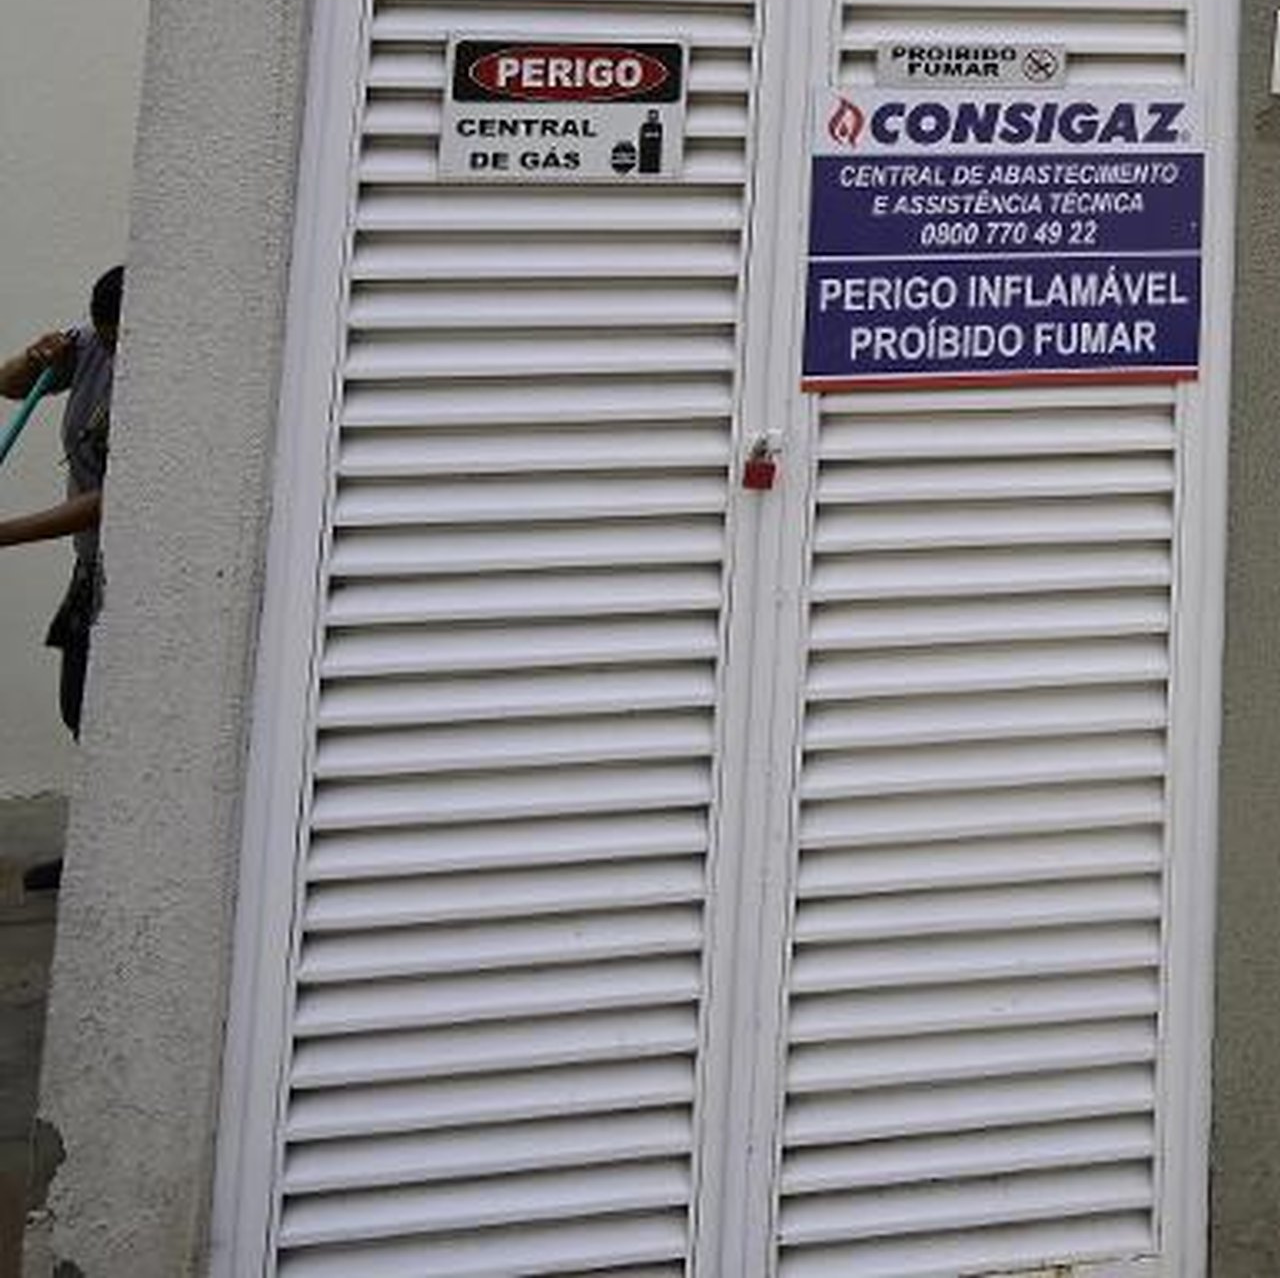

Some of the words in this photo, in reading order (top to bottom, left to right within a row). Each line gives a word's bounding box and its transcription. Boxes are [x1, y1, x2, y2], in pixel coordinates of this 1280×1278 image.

[891, 46, 1017, 61] PROIBIDO
[496, 58, 643, 89] PERIGO
[907, 63, 1000, 78] FUMAR
[456, 118, 597, 138] CENTRAL
[870, 101, 1186, 145] CONSIGAZ
[470, 152, 510, 171] DE
[519, 146, 581, 171] GÁS
[839, 165, 946, 188] CENTRAL
[951, 165, 982, 186] DE
[988, 162, 1179, 185] ABASTECIMENTO
[871, 194, 890, 215] E
[894, 189, 1043, 215] ASSISTÊNCIA
[1050, 187, 1144, 214] TÉCNICA
[920, 223, 979, 246] 0800
[986, 223, 1027, 245] 770
[1034, 221, 1064, 245] 49
[1069, 220, 1098, 244] 22
[818, 276, 958, 313] PERIGO
[968, 266, 1189, 309] INFLAMÁVEL
[1034, 321, 1157, 356] FUMAR
